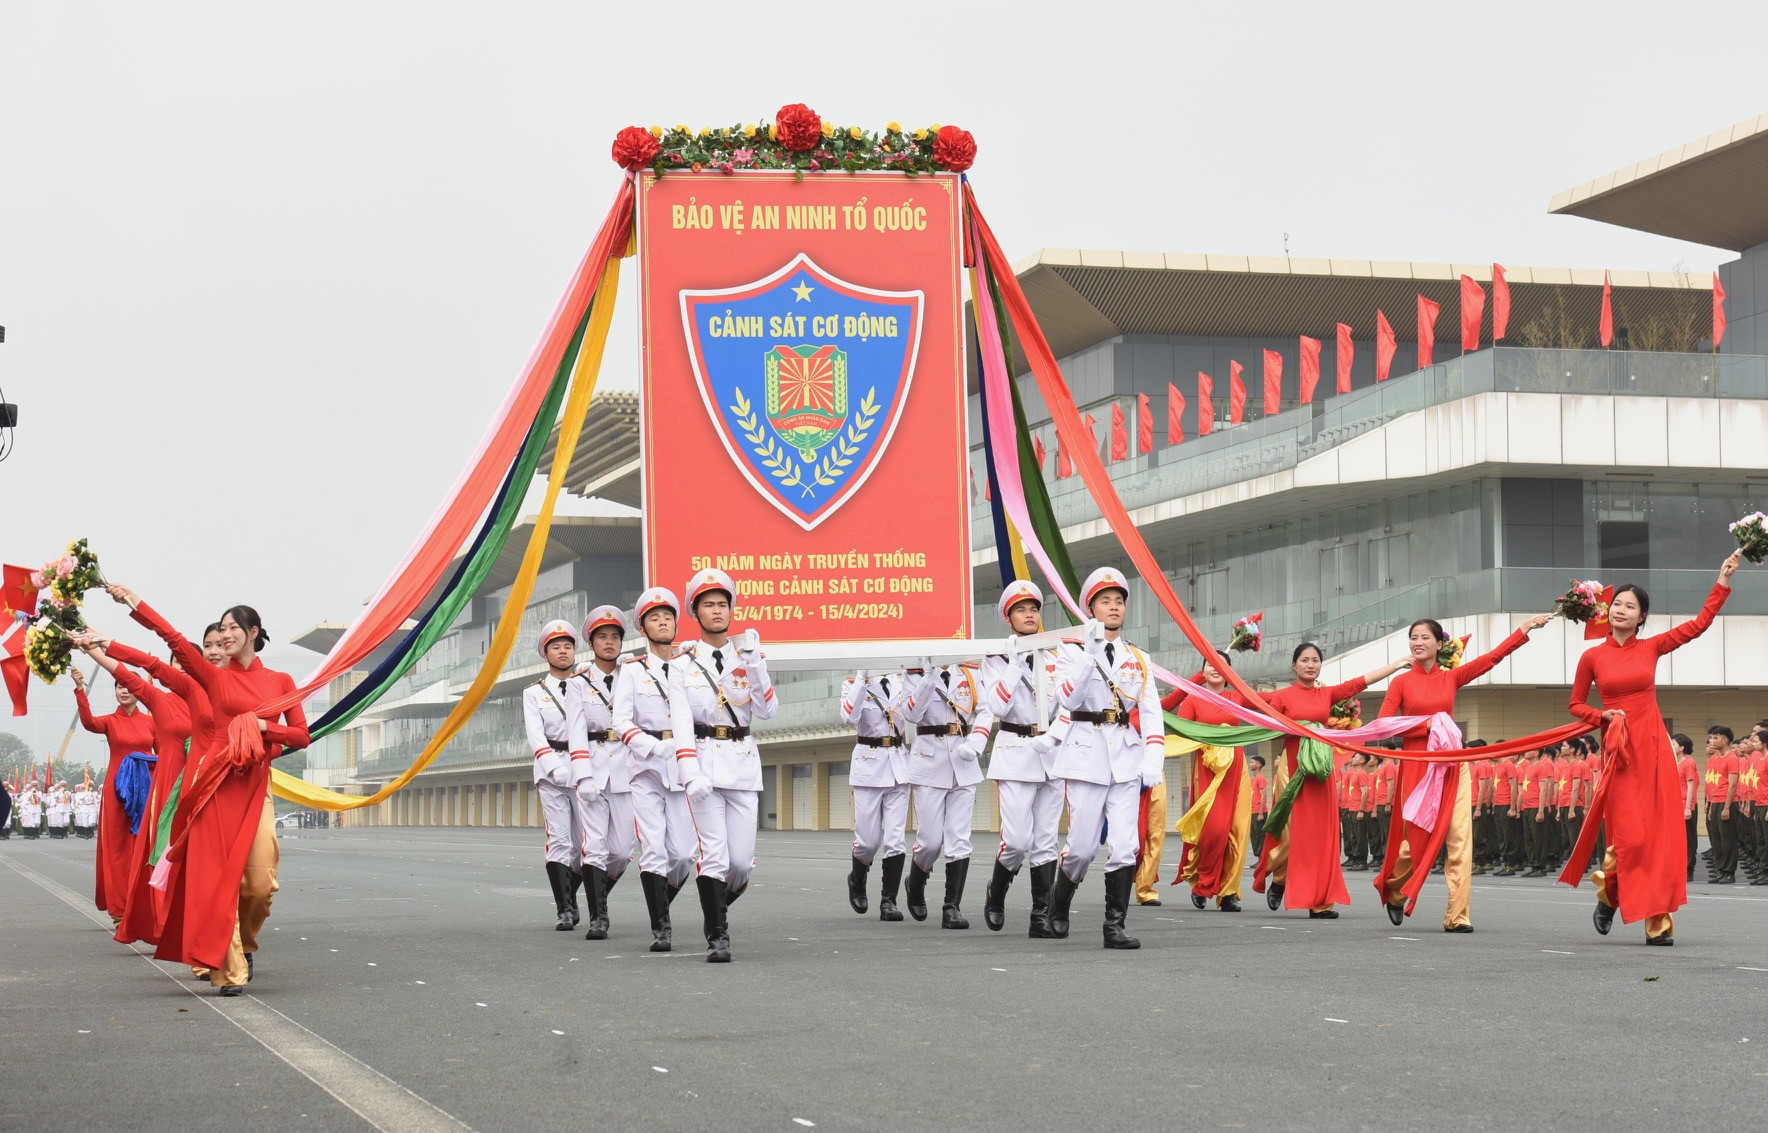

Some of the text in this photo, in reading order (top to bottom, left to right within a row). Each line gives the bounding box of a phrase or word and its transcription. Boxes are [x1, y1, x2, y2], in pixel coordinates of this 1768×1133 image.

[672, 197, 927, 235] BẢO VỆ AN NINH TỔ QUỐC
[709, 309, 898, 342] CẢNH SÁT CƠ ĐỘNG
[691, 547, 926, 571] 50 NĂM NGÀY TRUYỀN THỐNG
[735, 574, 934, 599] ƯỢNG CẢNH SÁT CƠ ĐỘNG
[733, 605, 803, 622] 5/4/1974
[821, 603, 904, 621] 15/4/2024)
